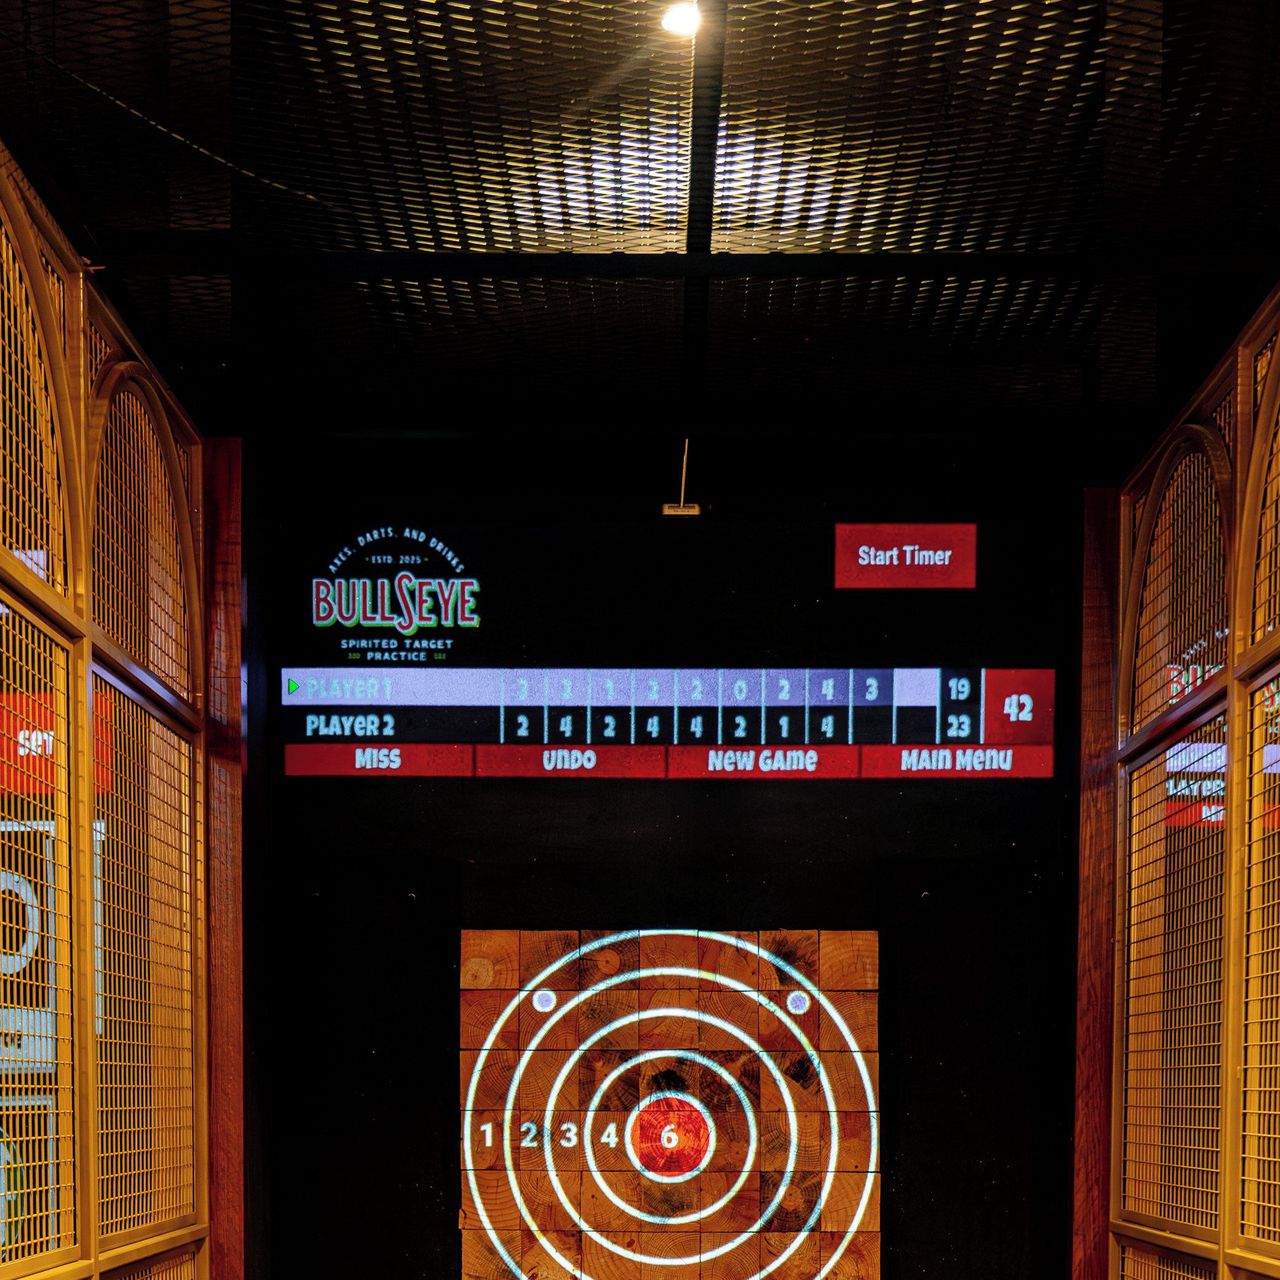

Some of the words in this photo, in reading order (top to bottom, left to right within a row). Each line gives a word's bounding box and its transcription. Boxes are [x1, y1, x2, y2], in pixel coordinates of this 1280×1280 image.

[403, 528, 426, 543] AND
[429, 537, 465, 573] DRINKS
[858, 545, 899, 566] Start
[902, 544, 953, 566] Timer
[312, 570, 481, 636] BULLSEYE
[341, 639, 398, 649] SPIRITED
[404, 639, 453, 649] TARGET
[367, 652, 427, 661] PRACTICE
[734, 678, 747, 700] 0
[778, 678, 790, 700] 2
[822, 678, 834, 700] 4
[866, 678, 878, 700] 3
[948, 678, 970, 700] 19
[1004, 694, 1034, 722] 42
[383, 714, 395, 736] 2
[517, 714, 529, 737] 2
[559, 714, 572, 737] 4
[604, 714, 616, 737] 2
[647, 714, 659, 737] 4
[690, 714, 703, 737] 4
[734, 714, 747, 737] 2
[779, 714, 790, 737] 1
[821, 714, 834, 737] 4
[947, 714, 970, 737] 23
[480, 1123, 493, 1148] 1
[520, 1123, 537, 1148] 2
[560, 1123, 578, 1148] 3
[600, 1123, 619, 1148] 4
[660, 1124, 679, 1149] 6
